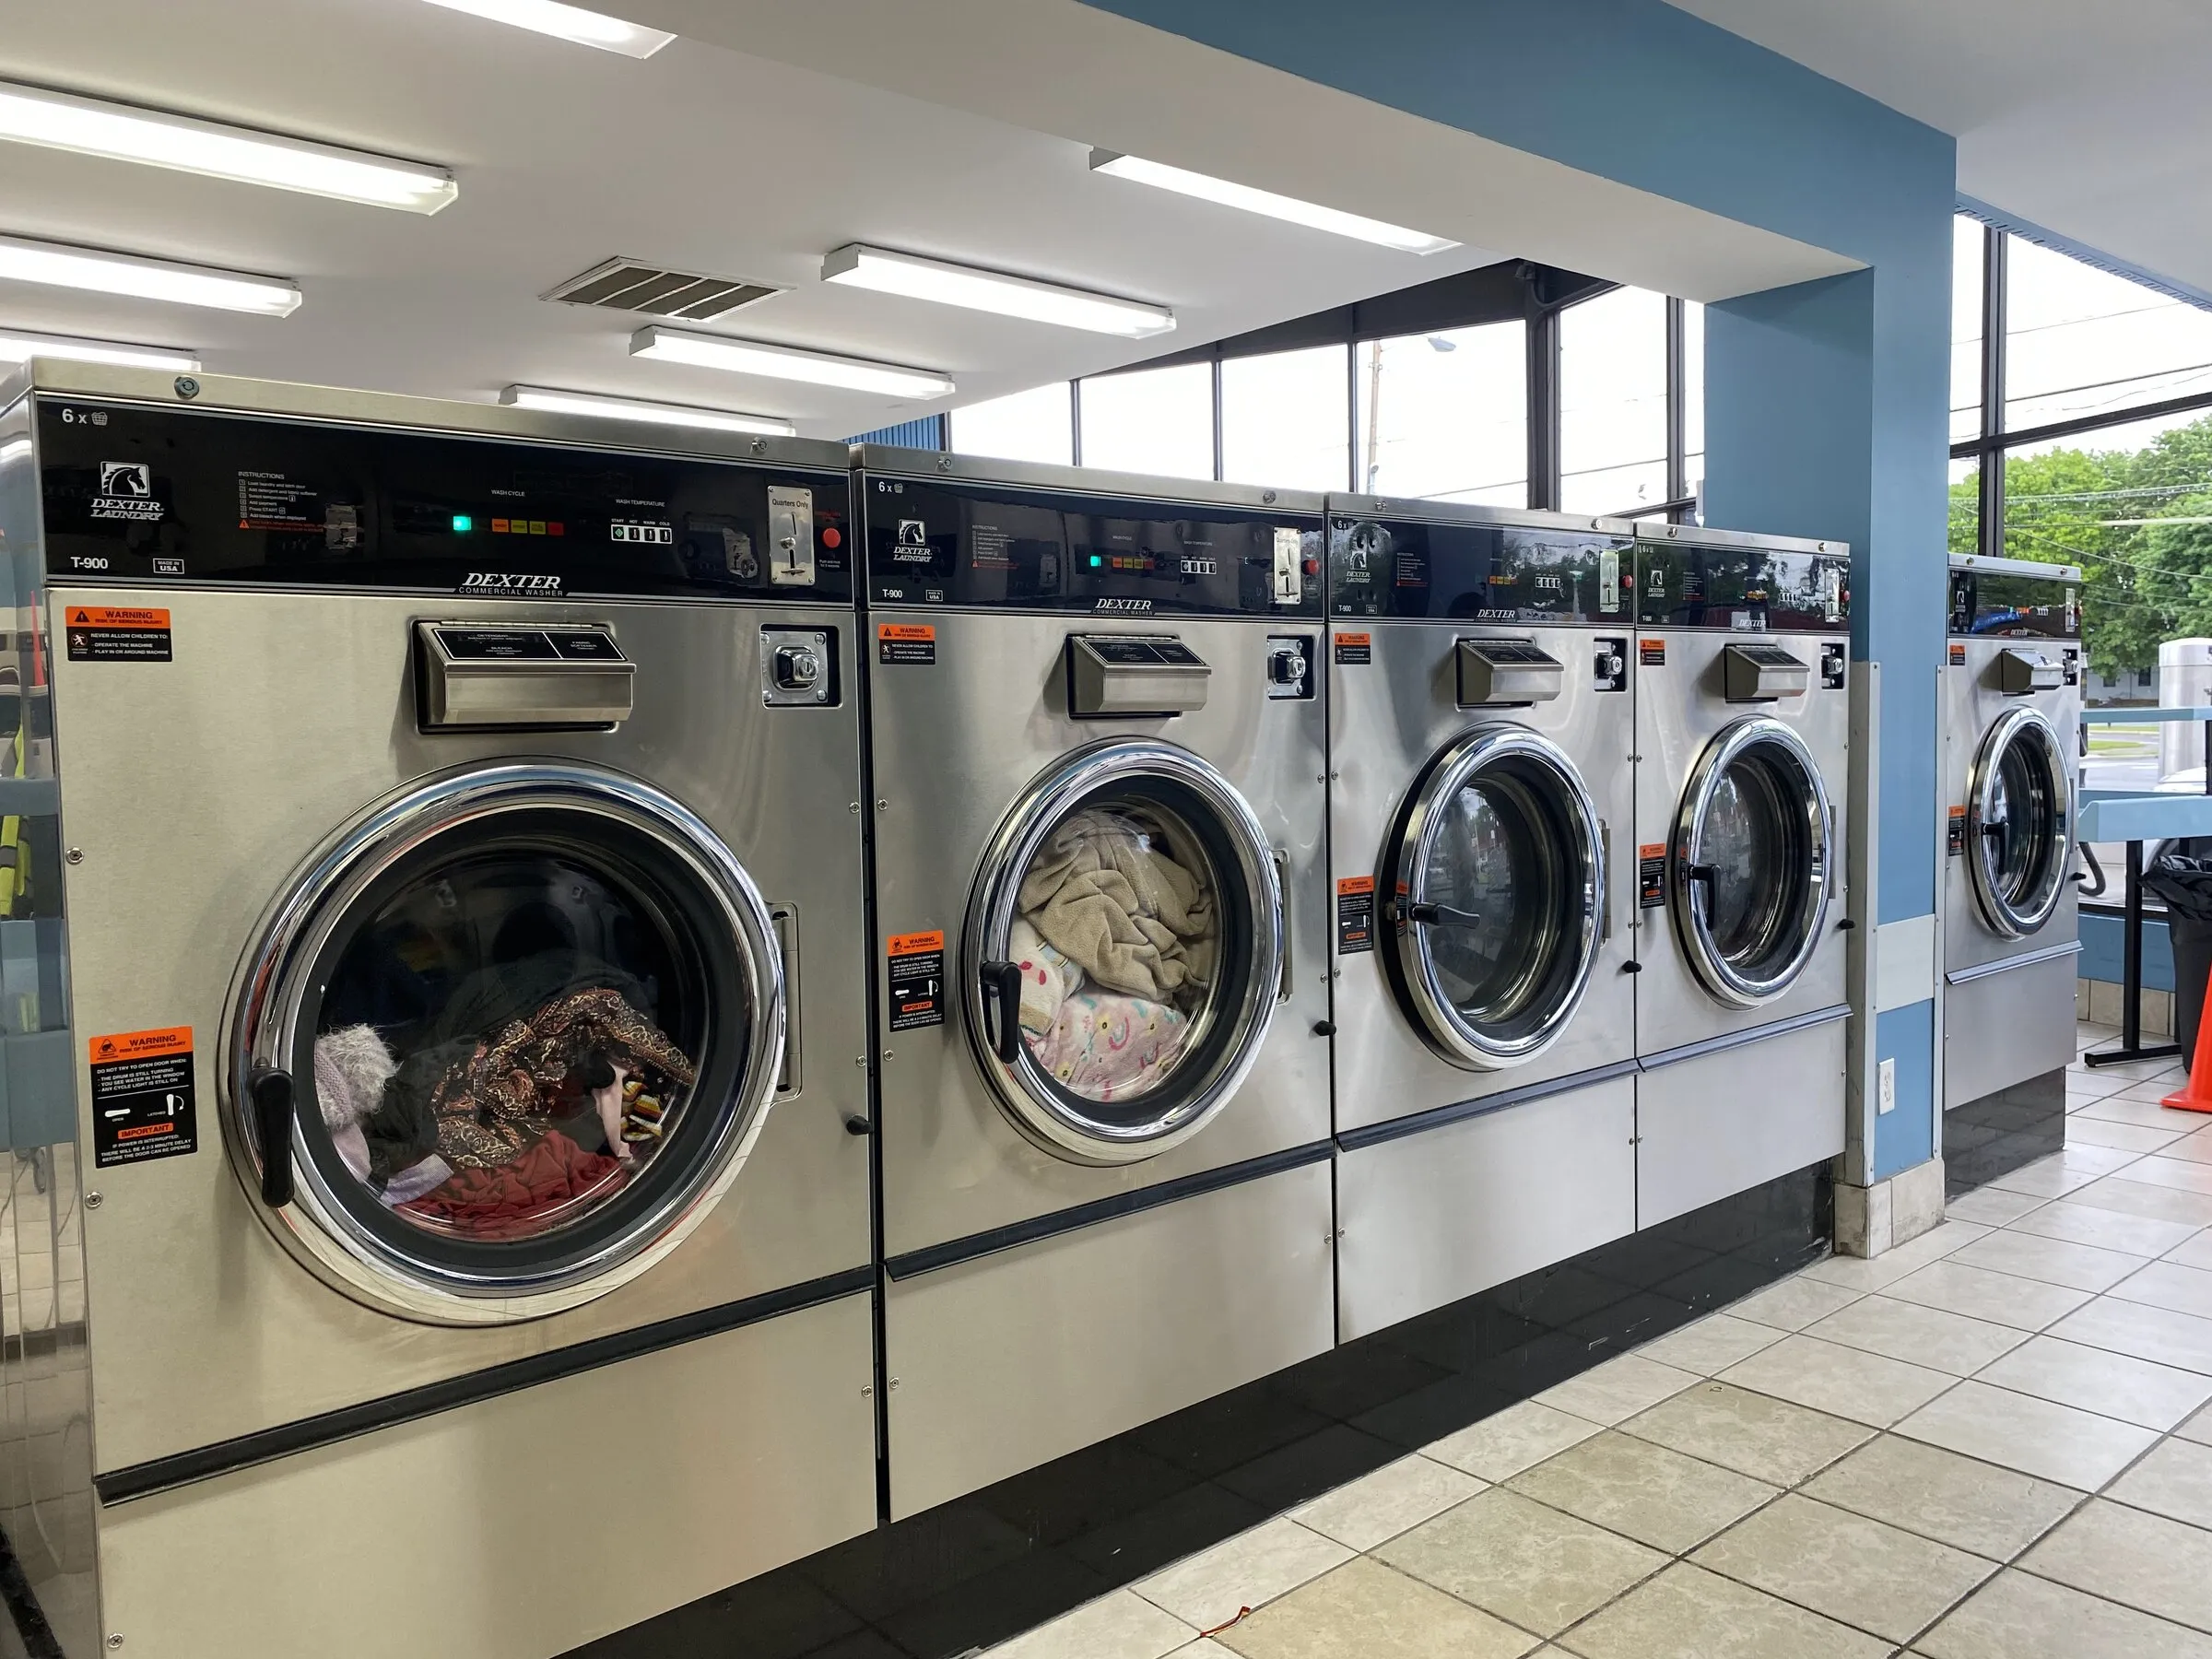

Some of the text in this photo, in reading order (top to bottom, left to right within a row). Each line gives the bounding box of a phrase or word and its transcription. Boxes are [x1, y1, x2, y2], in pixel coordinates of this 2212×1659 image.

[62, 408, 74, 423] 6
[238, 471, 285, 479] INSTRUCTIONS
[878, 481, 885, 492] 6
[90, 499, 161, 512] DEXTER
[772, 499, 808, 509] Quarters Only
[90, 509, 164, 521] LAUNDRY
[1337, 520, 1342, 529] 6
[893, 547, 931, 556] DEXTER
[70, 557, 109, 569] T-900
[893, 554, 932, 562] LAUNDRY
[462, 572, 560, 589] DEXTER
[459, 587, 522, 595] COMMERCIAL
[882, 589, 903, 598] T-900
[1095, 598, 1152, 610] DEXTER
[1477, 609, 1515, 618] DEXTER
[1738, 619, 1766, 628] DEXTER
[130, 1034, 176, 1046] WARNING
[122, 1124, 169, 1136] IMPORTANT
